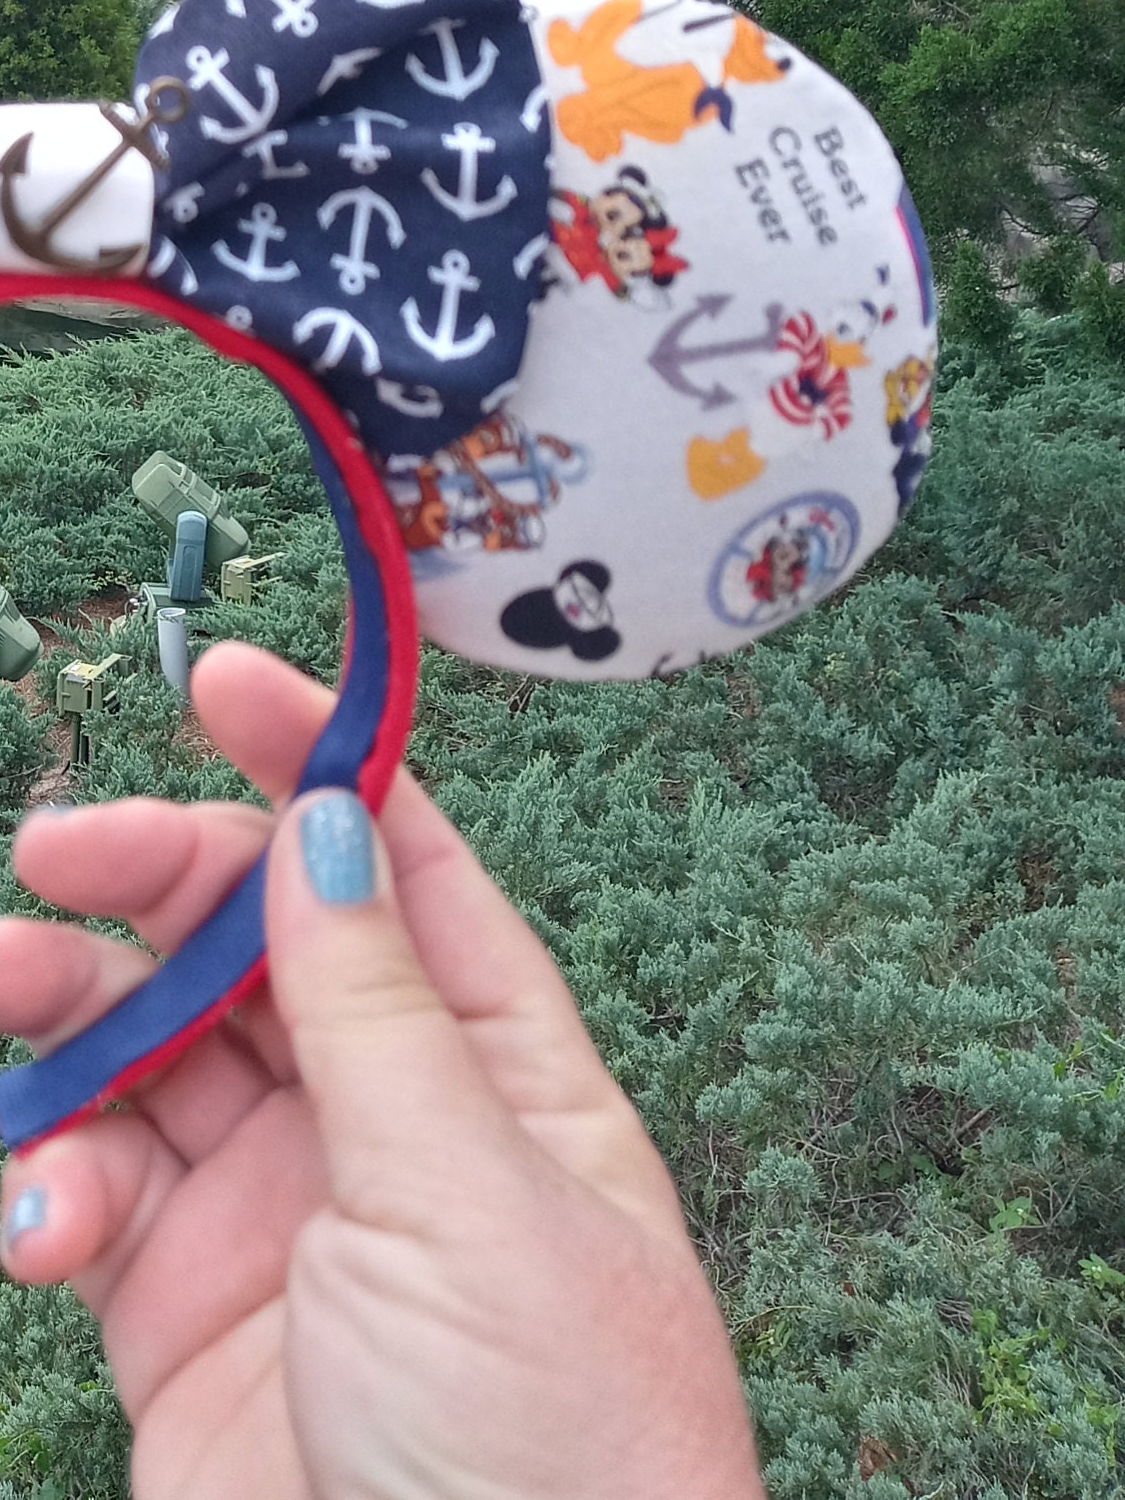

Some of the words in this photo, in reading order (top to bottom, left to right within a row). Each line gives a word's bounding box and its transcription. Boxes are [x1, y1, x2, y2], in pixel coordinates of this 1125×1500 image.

[734, 157, 791, 243] Ever
[769, 126, 838, 246] Cruise
[813, 125, 867, 210] Best
